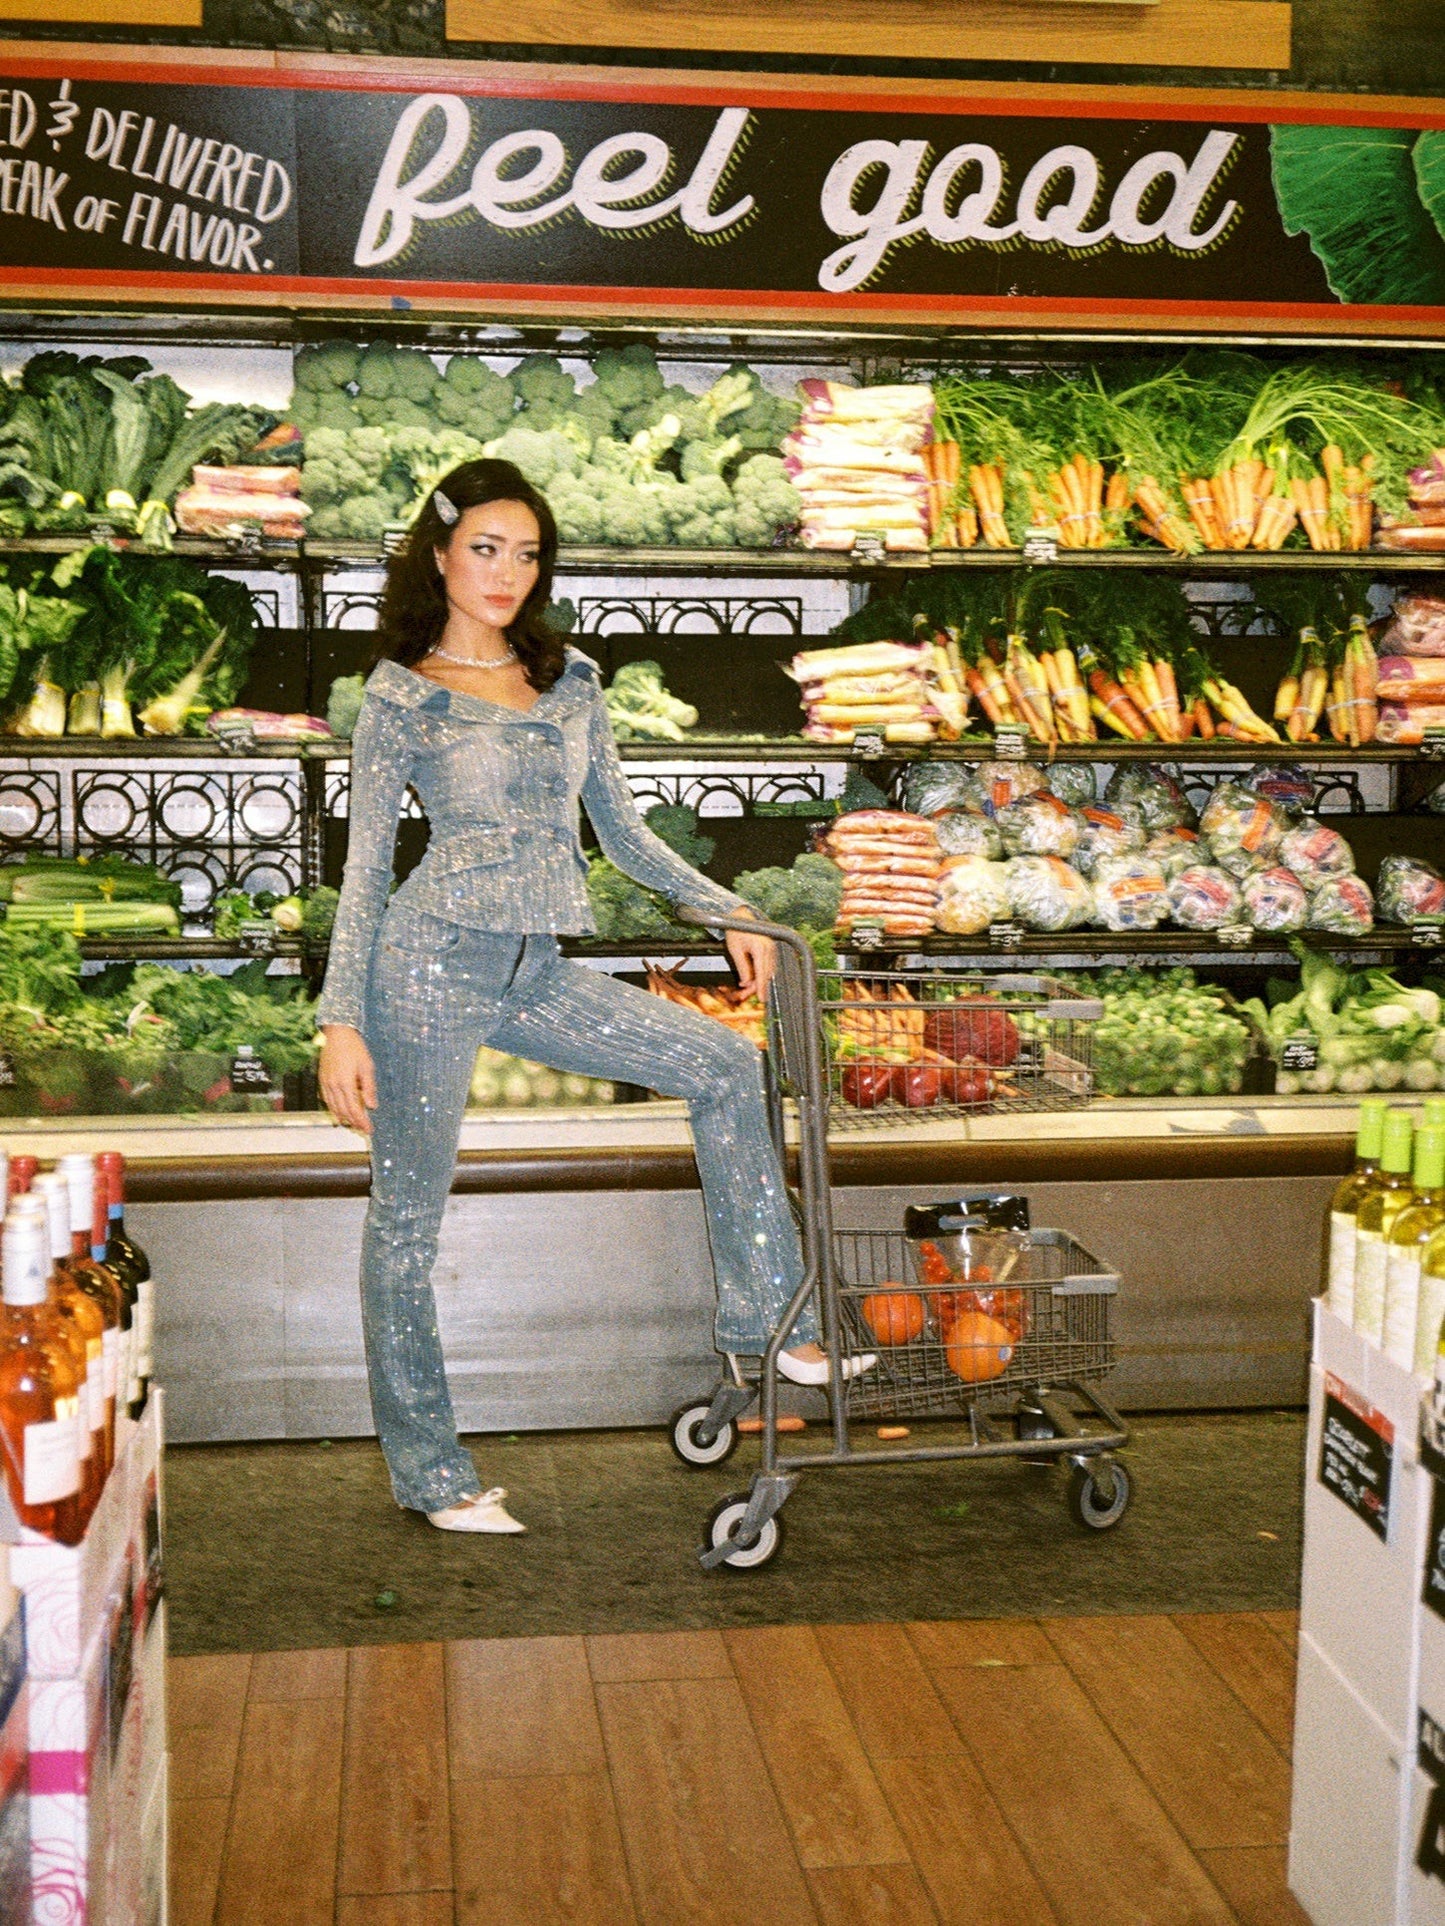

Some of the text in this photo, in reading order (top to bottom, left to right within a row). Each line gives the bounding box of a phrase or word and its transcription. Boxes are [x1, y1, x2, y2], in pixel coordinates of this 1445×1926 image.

[0, 158, 275, 273] EAK OF FLAVOR.
[85, 107, 291, 223] DELIVERED
[354, 94, 1240, 293] feel good
